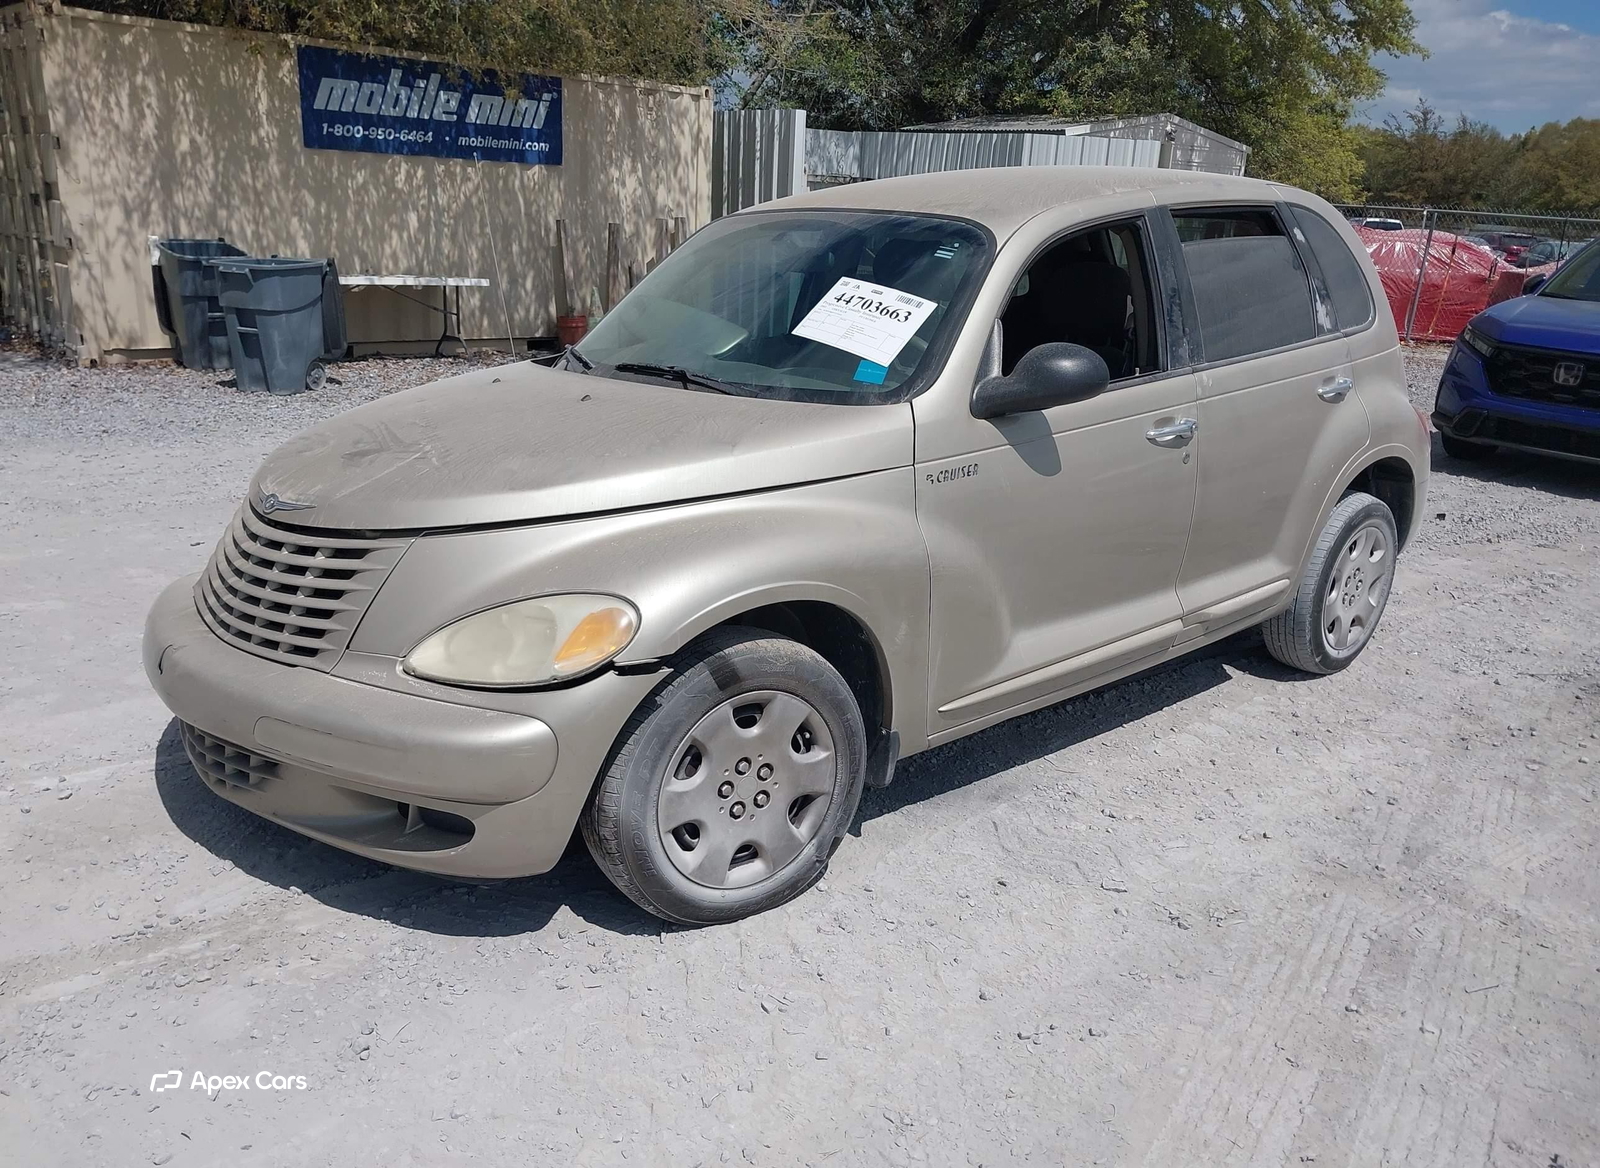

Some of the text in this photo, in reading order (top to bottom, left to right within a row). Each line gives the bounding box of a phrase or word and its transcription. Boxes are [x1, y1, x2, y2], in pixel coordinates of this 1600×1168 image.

[313, 68, 552, 129] mobile mini
[321, 122, 550, 152] 1-800-950-6464 mobilemini.com
[833, 291, 912, 324] 44703663
[936, 463, 979, 484] CRUISER
